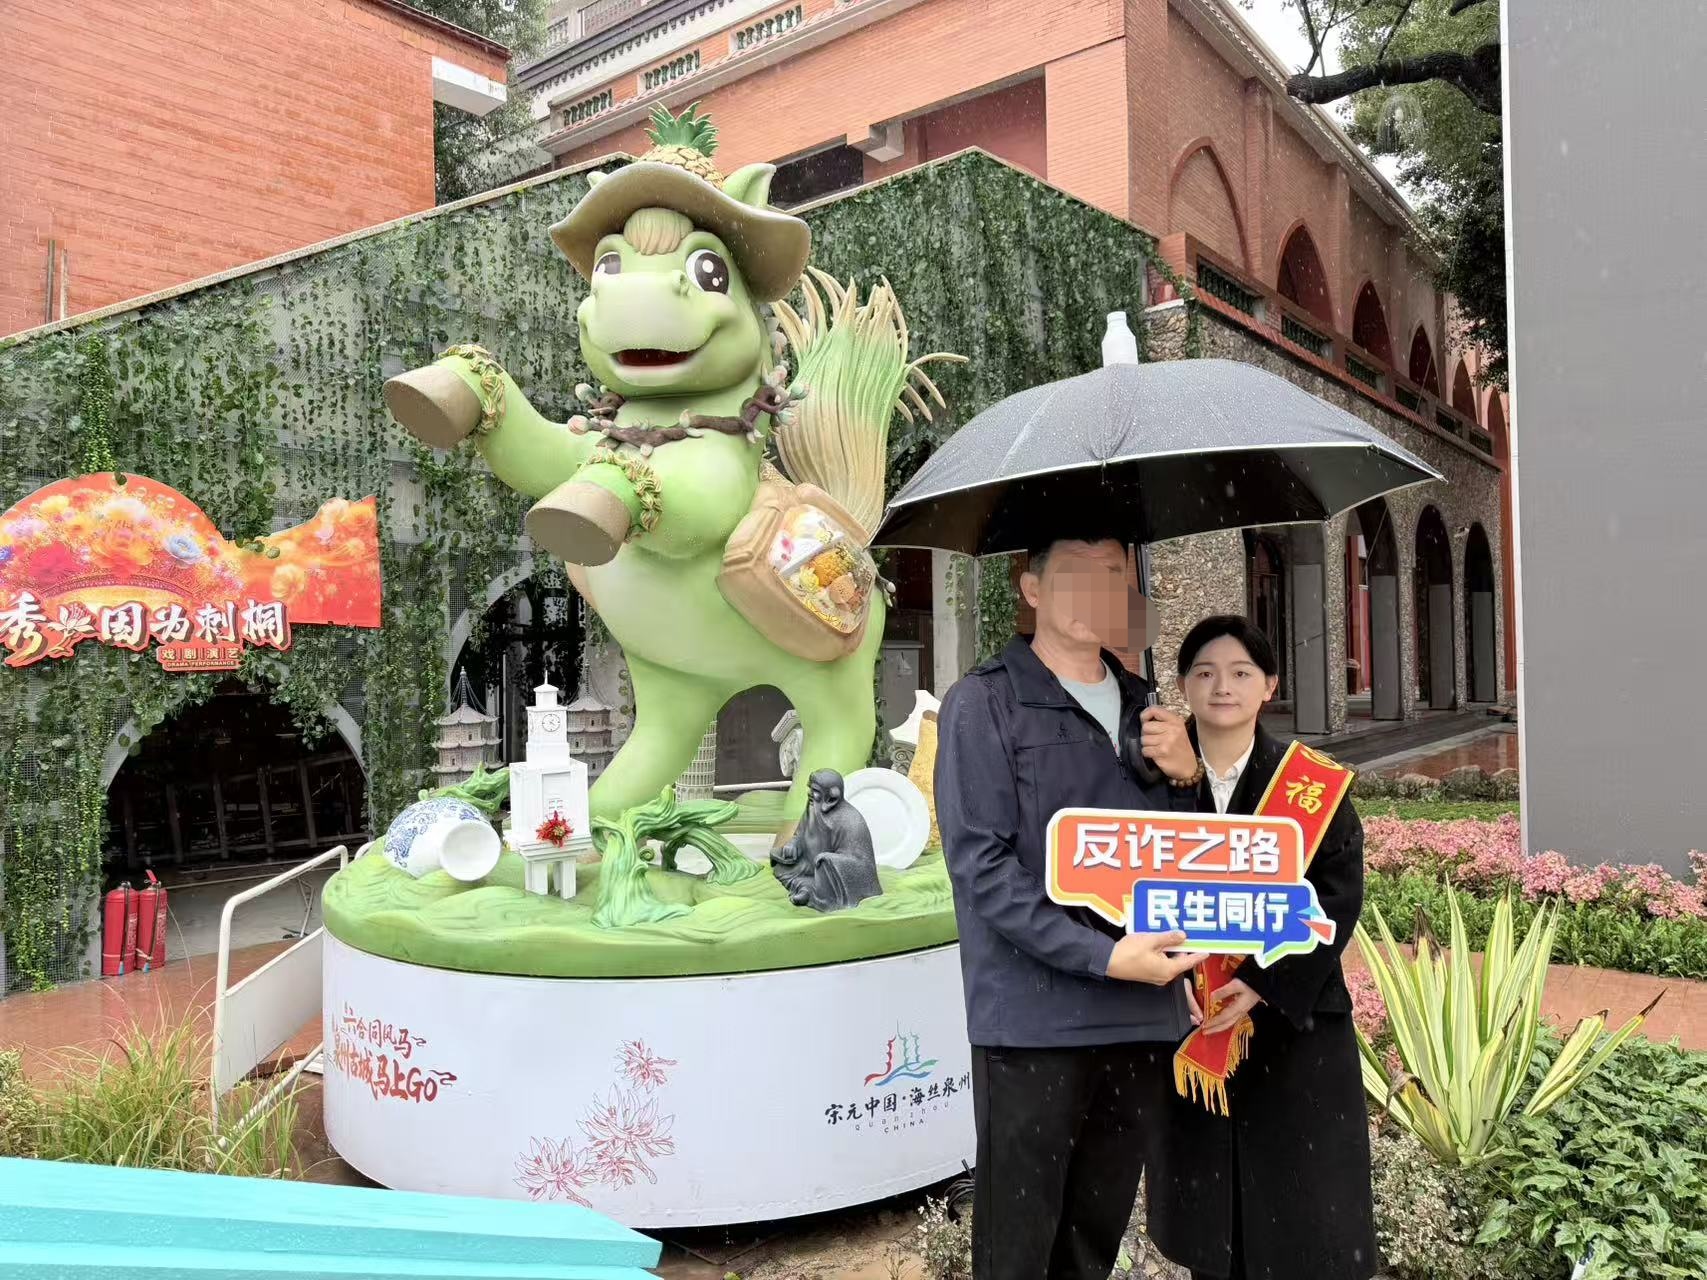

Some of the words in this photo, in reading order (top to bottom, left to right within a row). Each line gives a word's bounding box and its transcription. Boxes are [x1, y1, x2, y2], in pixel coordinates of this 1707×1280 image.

[191, 660, 235, 668] PERFORMANCE
[1286, 775, 1327, 814] 福
[1073, 822, 1280, 874] 反诈之路
[1147, 888, 1289, 932] 民生同行
[884, 1118, 924, 1133] CHINA
